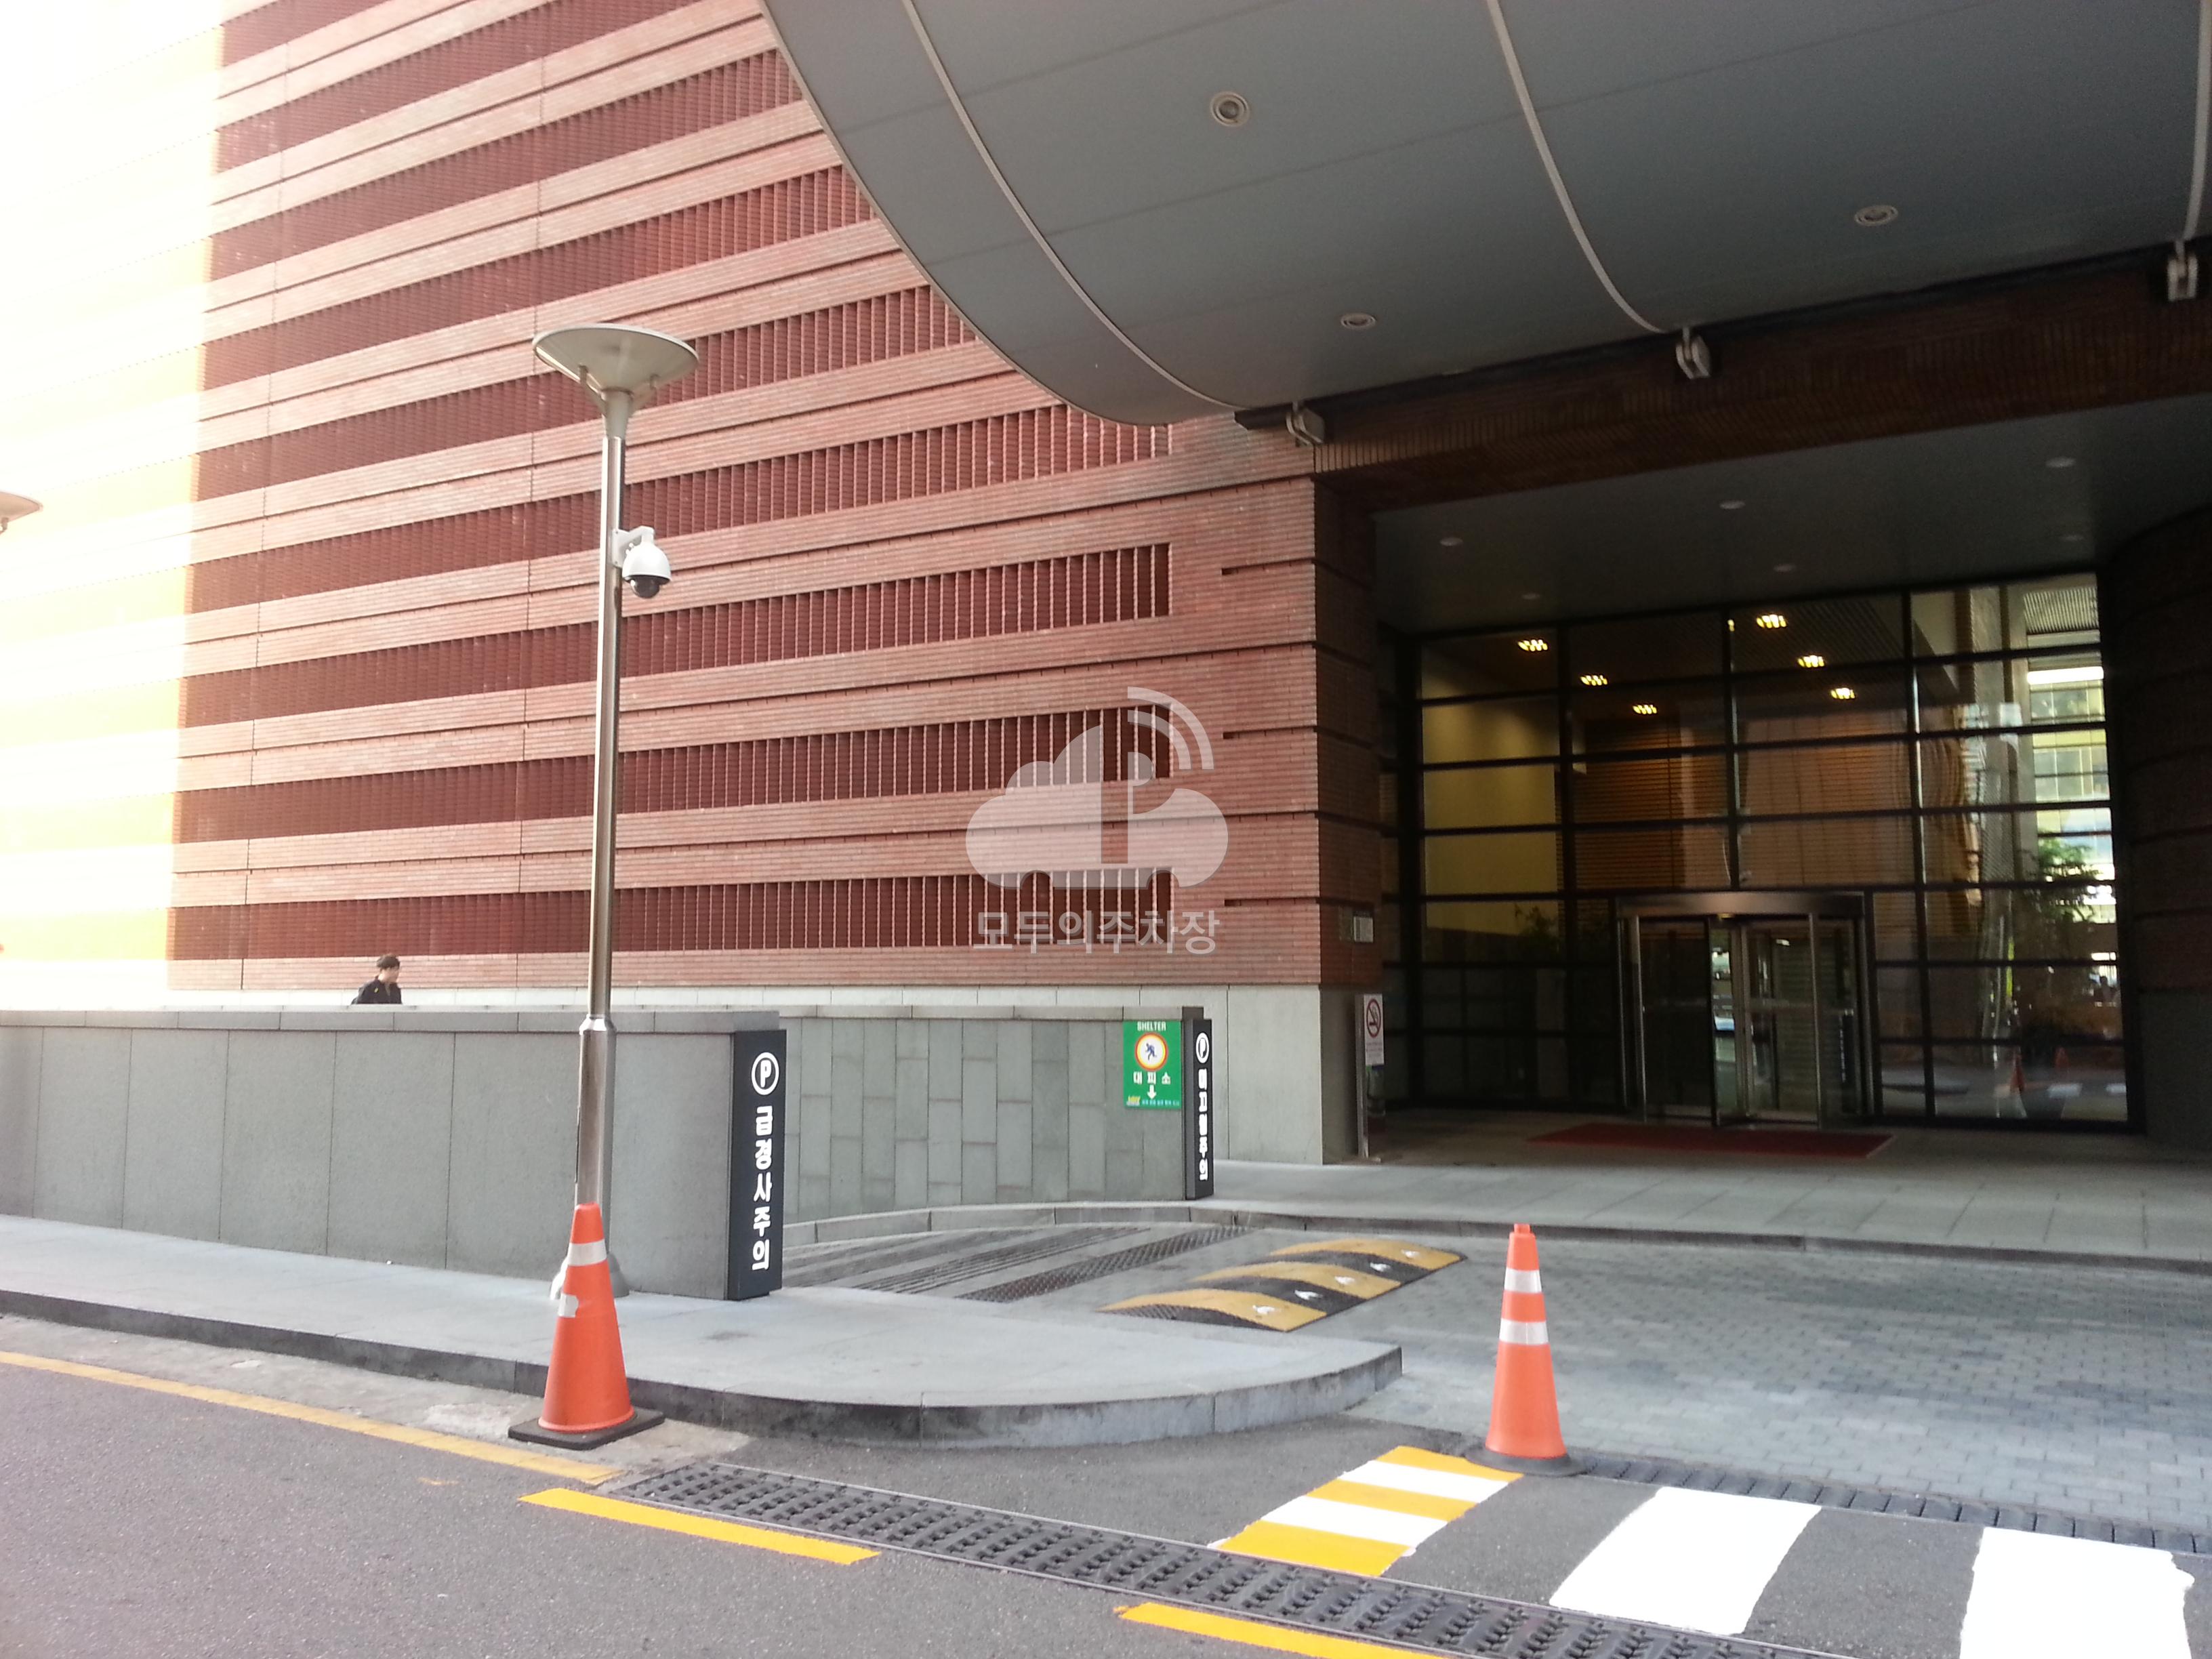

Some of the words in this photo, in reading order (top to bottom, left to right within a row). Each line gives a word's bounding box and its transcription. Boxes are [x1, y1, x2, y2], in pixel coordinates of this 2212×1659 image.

[1136, 1021, 1166, 1031] SHELTER
[1133, 1071, 1171, 1085] 대피소
[752, 1106, 773, 1271] 급경사주의
